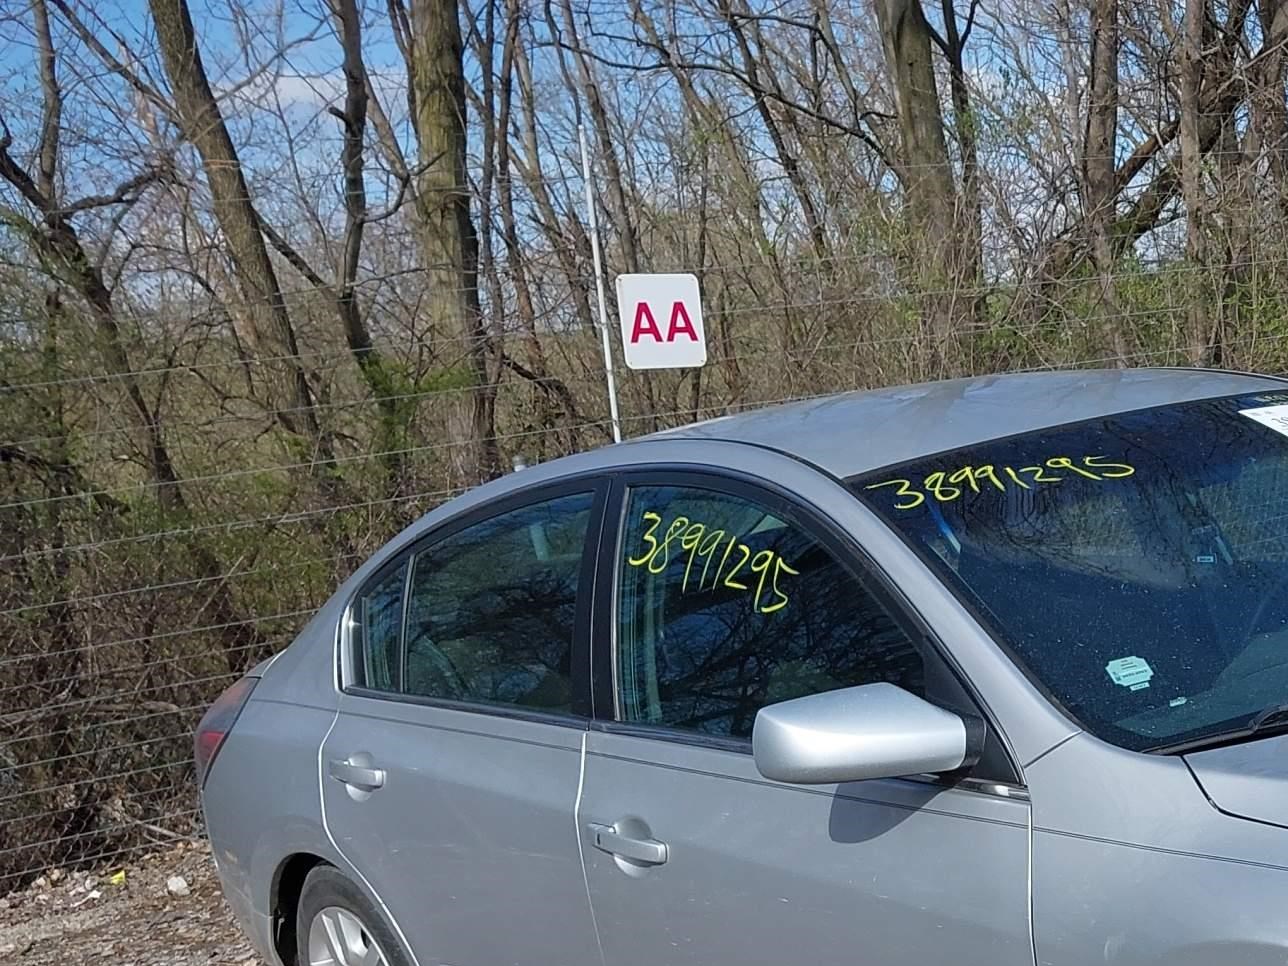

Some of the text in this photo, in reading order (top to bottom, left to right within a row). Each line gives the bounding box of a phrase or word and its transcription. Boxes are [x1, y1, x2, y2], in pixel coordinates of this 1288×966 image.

[630, 301, 699, 343] AA
[864, 455, 1136, 509] 38991295
[628, 511, 800, 614] 38991295
